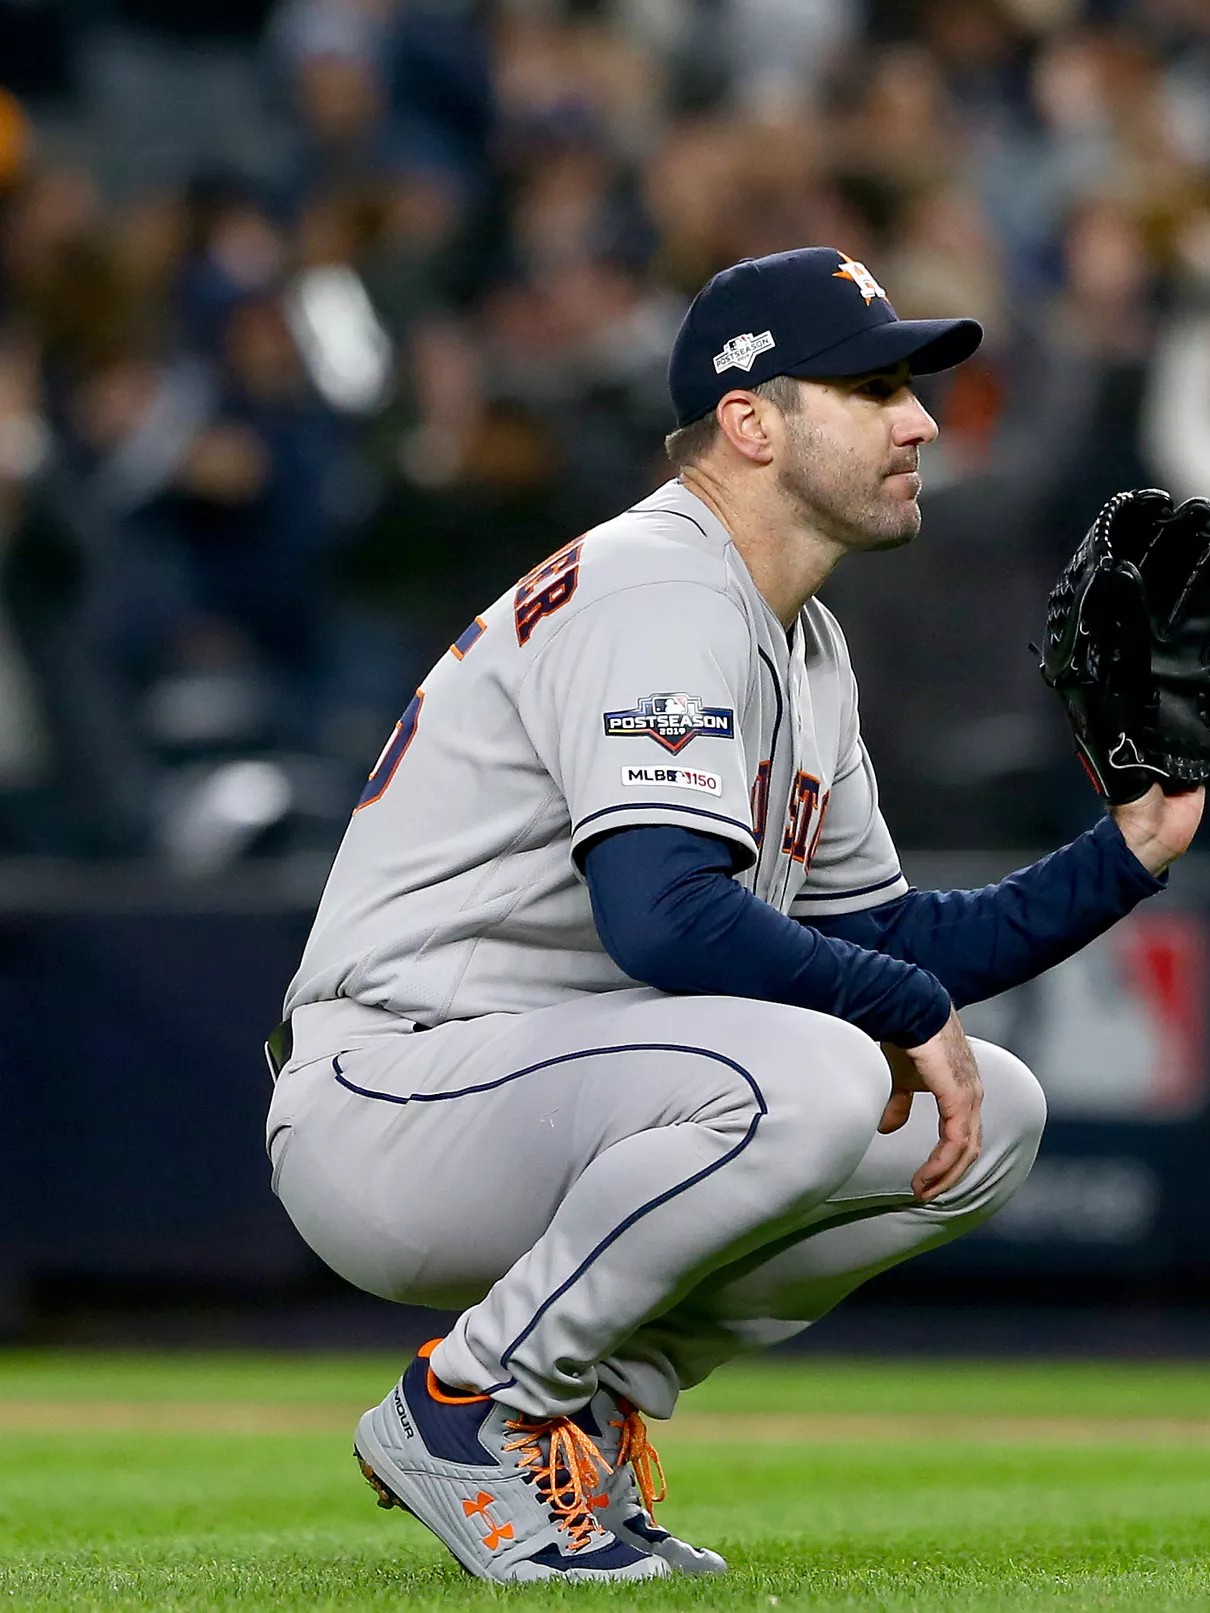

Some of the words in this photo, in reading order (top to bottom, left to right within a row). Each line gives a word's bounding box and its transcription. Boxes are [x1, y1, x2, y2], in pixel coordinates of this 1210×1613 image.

[716, 338, 769, 367] POSTSEASON
[609, 714, 728, 729] POSTSEASON
[659, 727, 686, 736] 2019
[628, 769, 666, 781] MLB
[692, 772, 717, 790] 150
